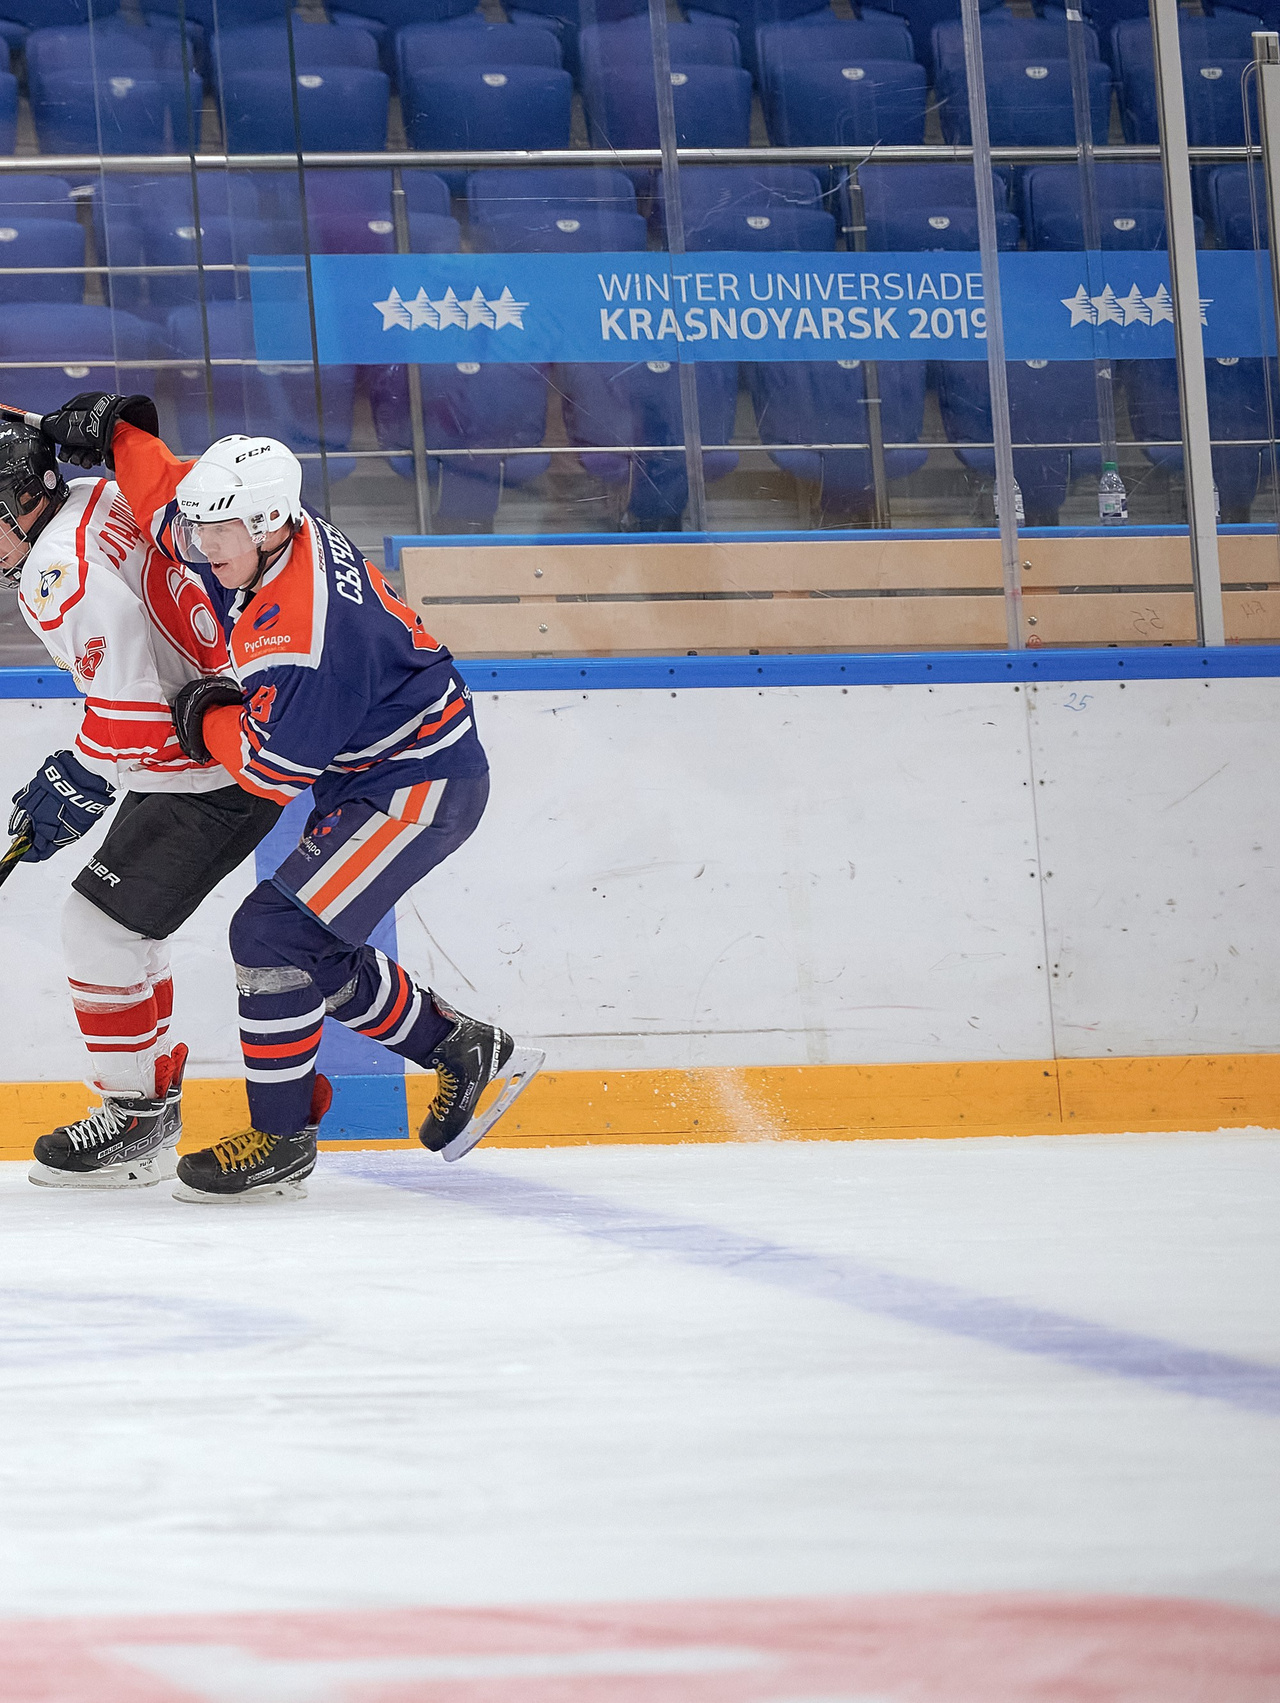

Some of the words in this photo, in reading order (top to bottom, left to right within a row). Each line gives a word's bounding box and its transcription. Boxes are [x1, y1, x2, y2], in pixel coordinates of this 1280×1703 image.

[598, 272, 740, 302] WINTER
[749, 272, 986, 301] UNIVERSIADE
[600, 307, 901, 342] KRASNOYARSK
[907, 307, 988, 339] 2019
[235, 445, 271, 464] CCM
[181, 500, 200, 508] CCM
[244, 635, 291, 653] РусГидро
[1063, 692, 1094, 712] 25
